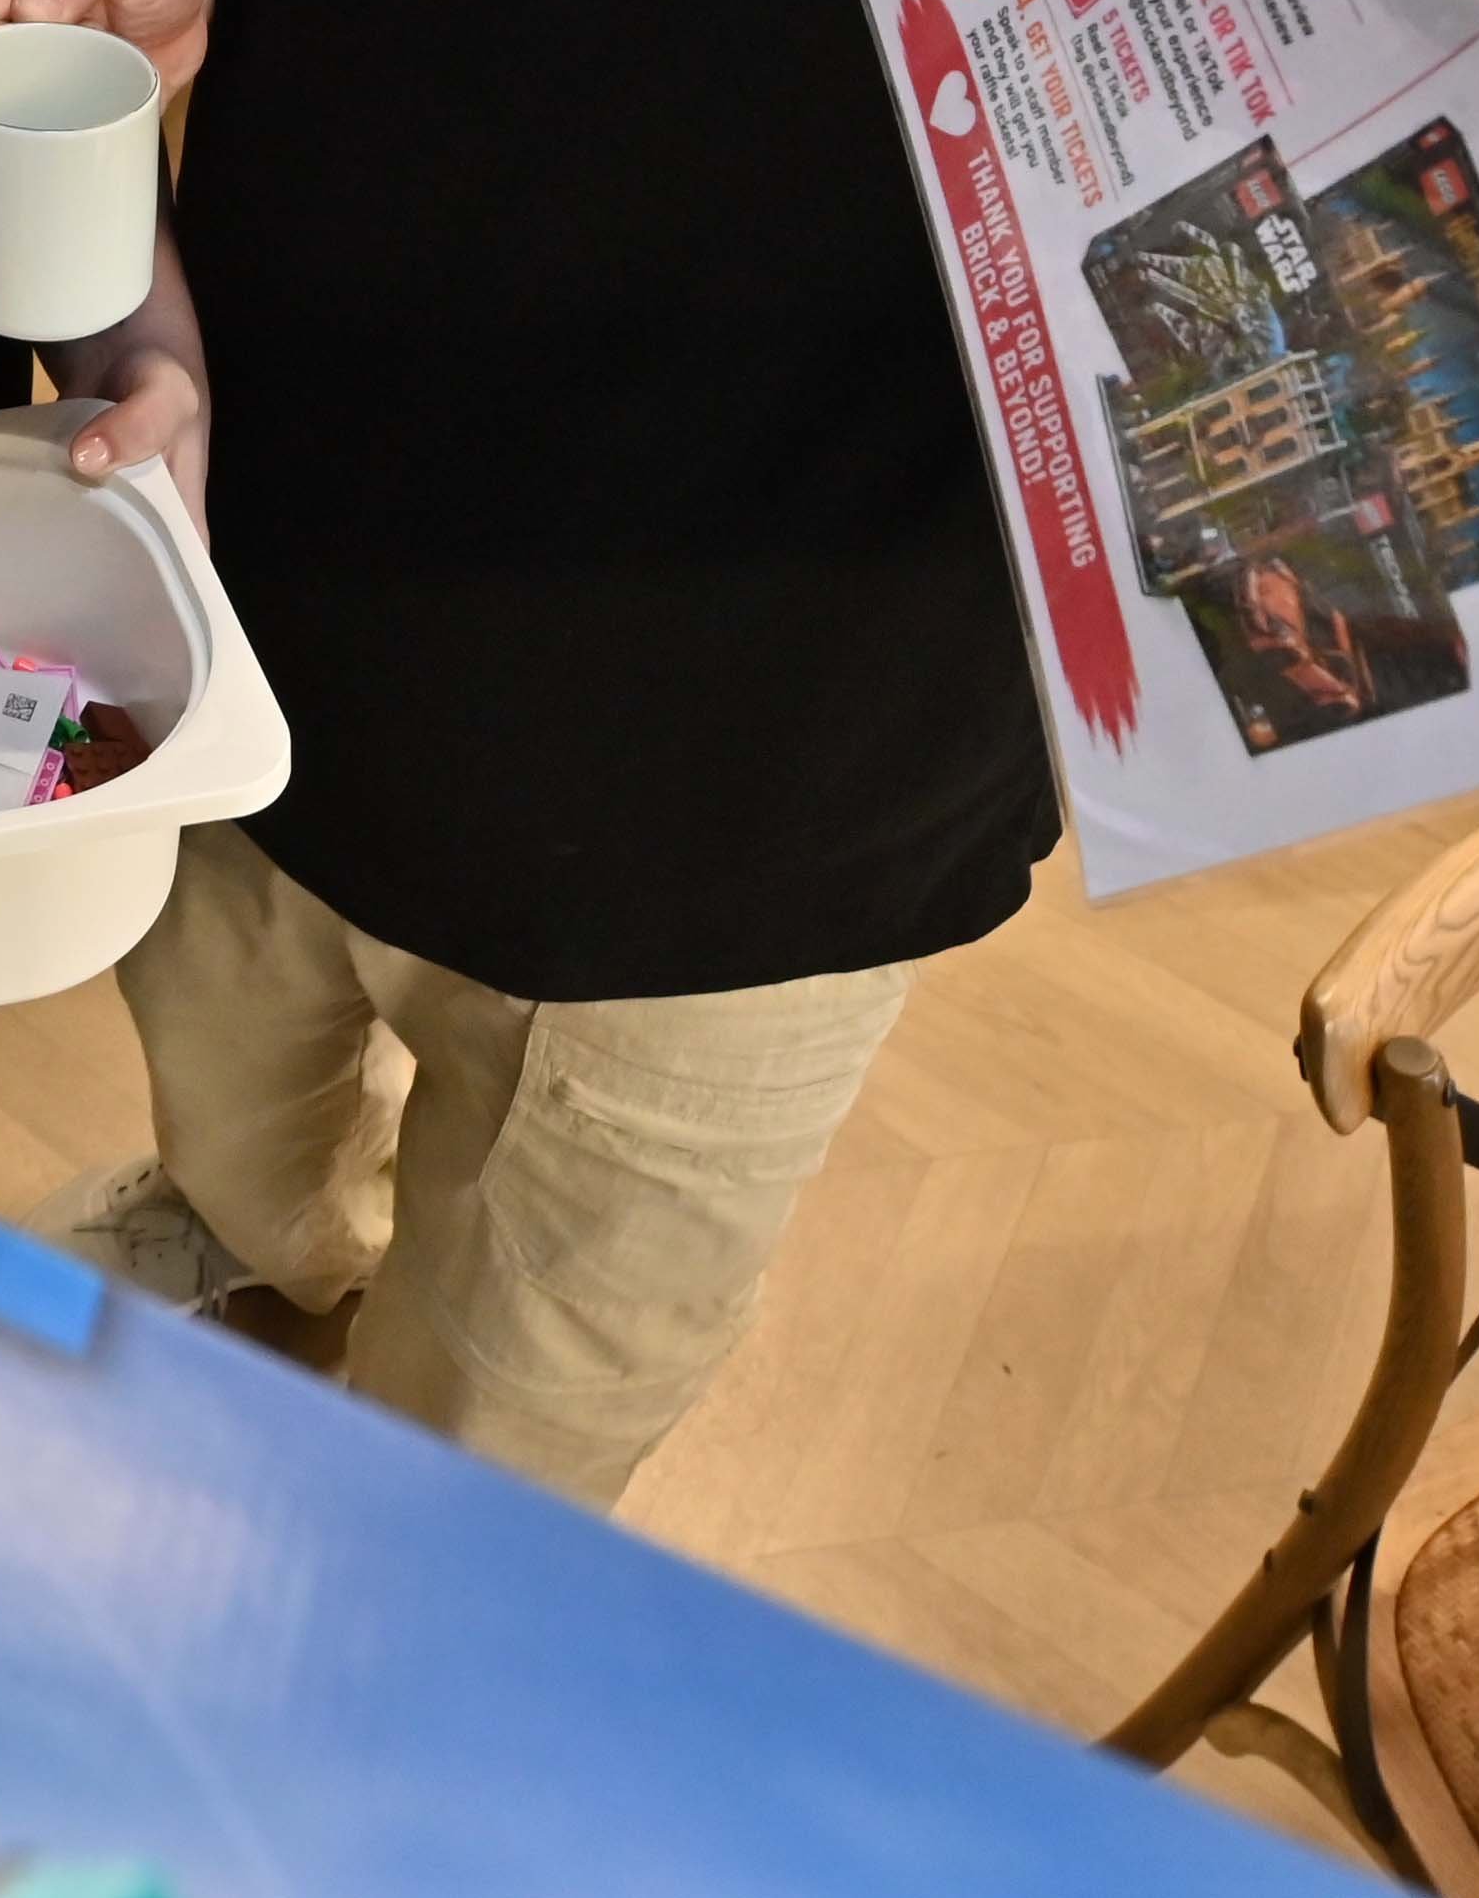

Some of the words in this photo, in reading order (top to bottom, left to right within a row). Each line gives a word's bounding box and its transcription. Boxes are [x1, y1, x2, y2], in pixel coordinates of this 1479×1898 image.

[996, 4, 1021, 55] Speak
[1039, 116, 1067, 186] member
[1109, 22, 1152, 105] TICKETS
[1168, 31, 1216, 128] experience
[1193, 36, 1225, 99] TikTok
[1207, 3, 1237, 43] OR
[1224, 36, 1256, 81] TIK
[1243, 75, 1278, 128] TOK
[1024, 19, 1054, 62] GET
[1040, 59, 1075, 123] YOUR
[1060, 119, 1105, 209] TICKETS
[967, 146, 1014, 249] THANK
[960, 220, 1003, 314] BRICK
[995, 247, 1030, 310] YOU
[985, 316, 1010, 345] &
[1011, 310, 1045, 372] FOR
[995, 350, 1048, 488] BEYOND!
[1027, 375, 1098, 569] SUPPORTING
